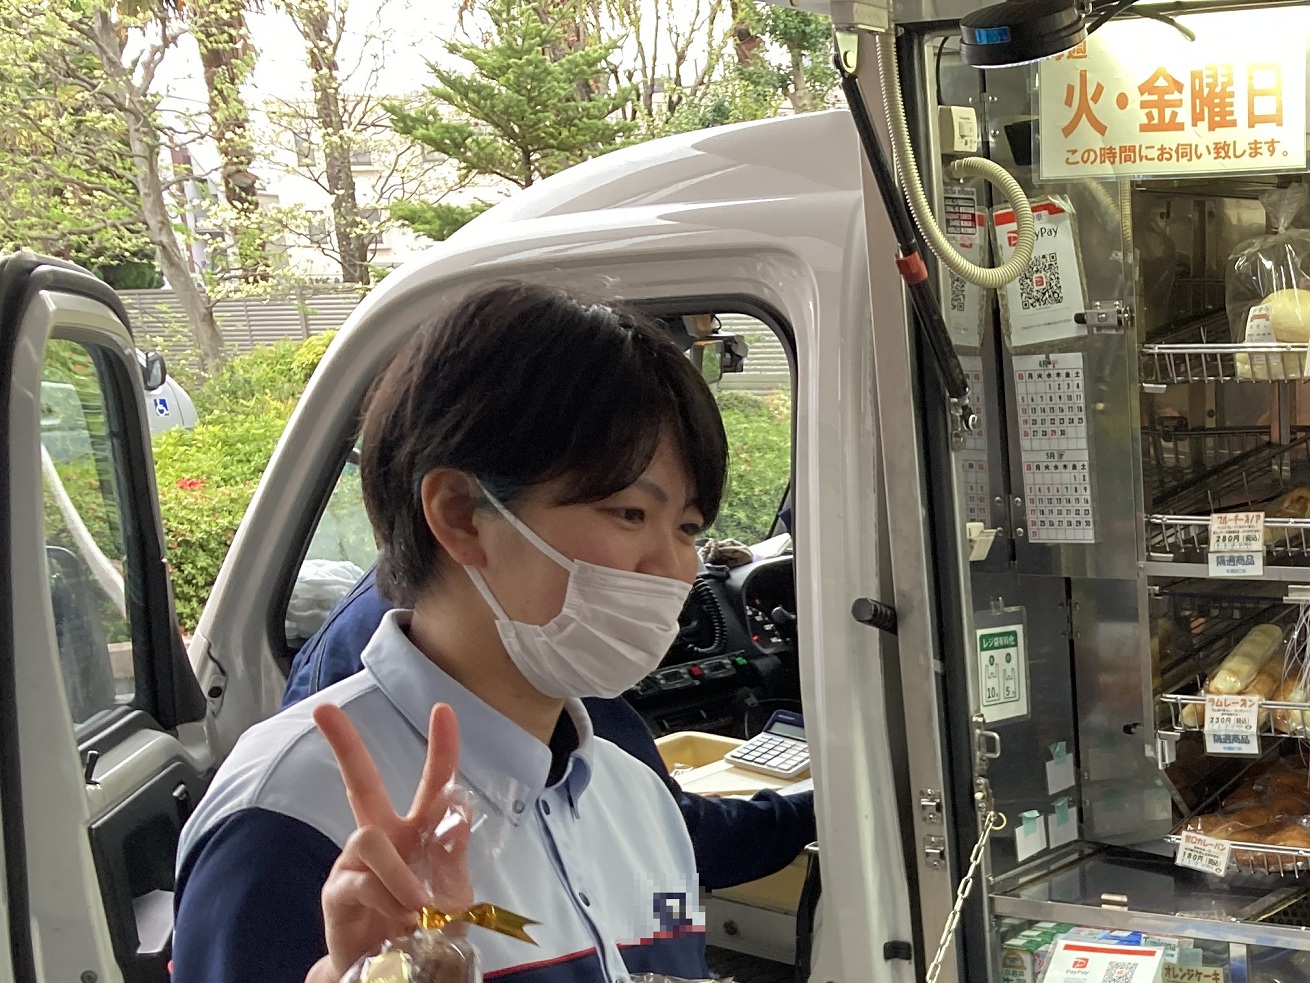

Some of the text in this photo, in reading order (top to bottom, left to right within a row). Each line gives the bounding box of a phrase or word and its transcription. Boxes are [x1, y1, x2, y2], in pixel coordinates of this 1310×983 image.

[1061, 63, 1283, 138] 火・金曜日
[1064, 139, 1289, 166] この時間にお伺い致します。
[982, 635, 1015, 649] レジ袋有料化
[1208, 698, 1256, 707] ラムレーズン
[1164, 965, 1220, 983] オレンジケーキ
